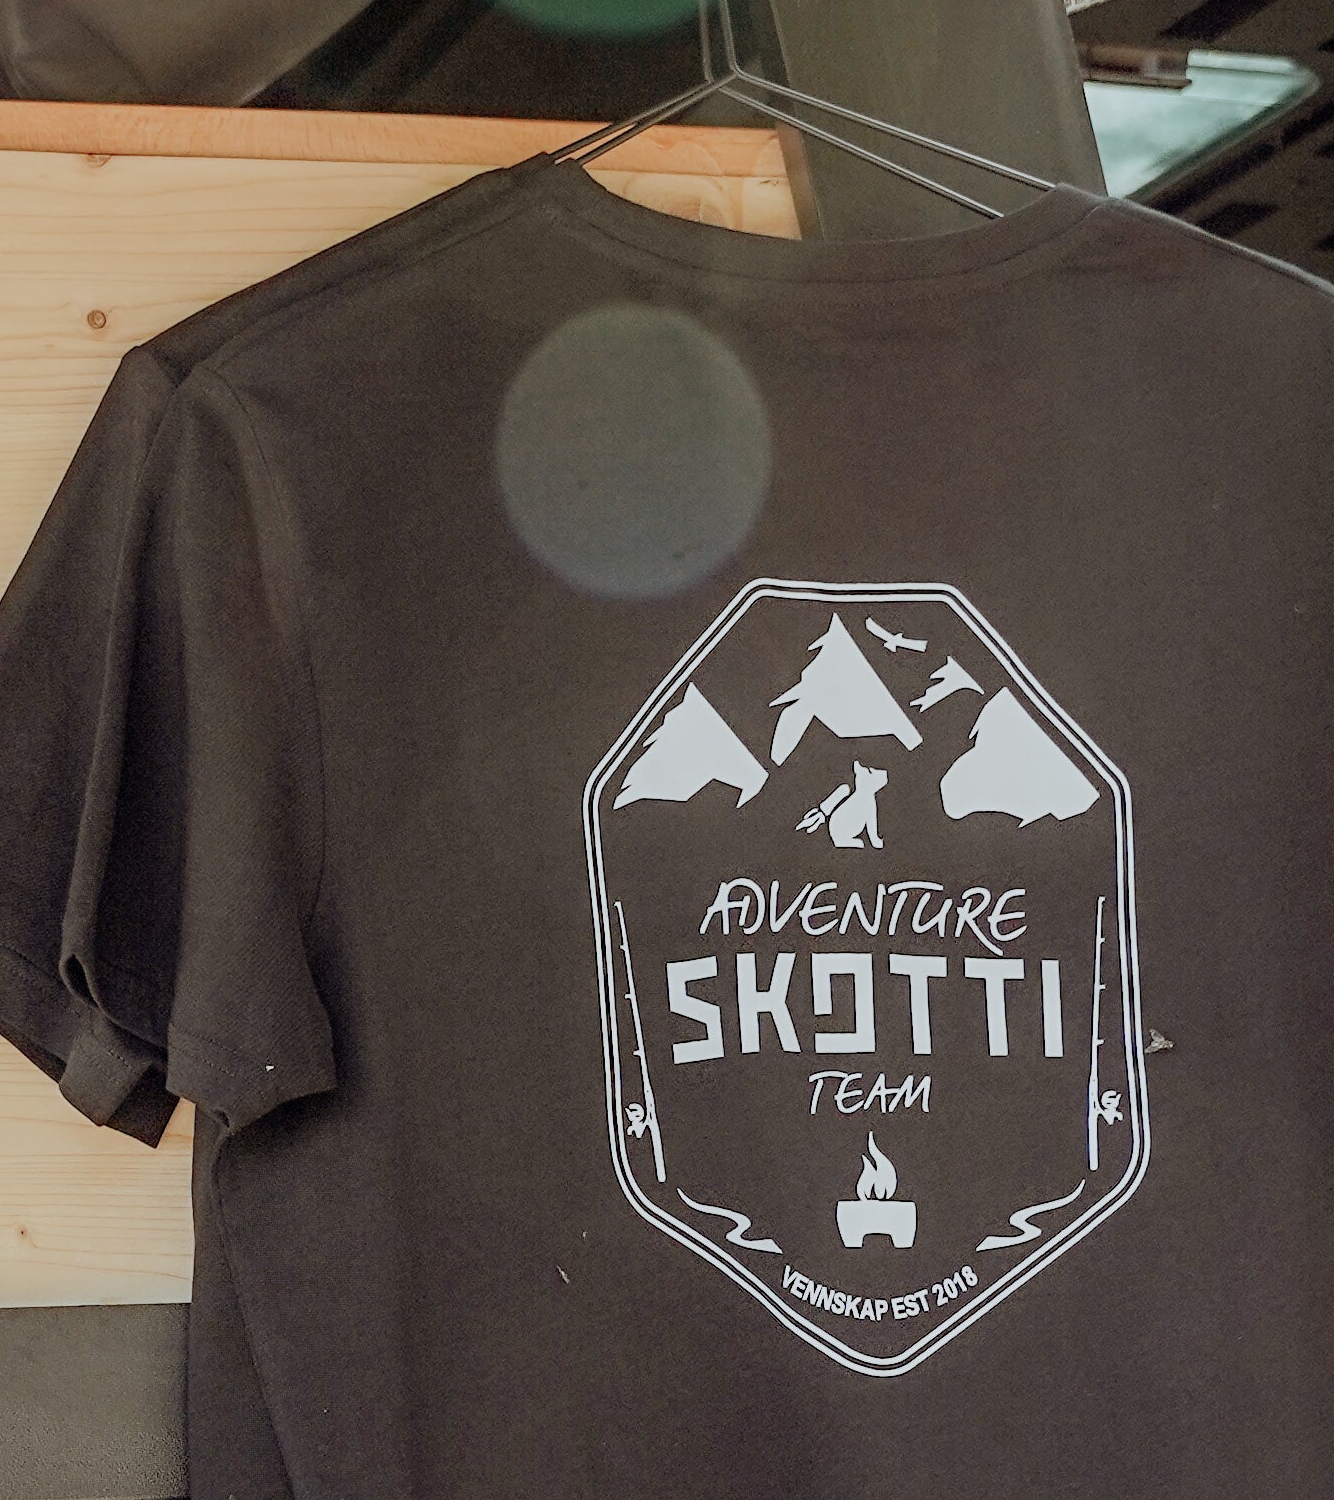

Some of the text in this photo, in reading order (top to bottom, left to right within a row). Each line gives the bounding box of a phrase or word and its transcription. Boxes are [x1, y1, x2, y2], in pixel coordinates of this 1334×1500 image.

[699, 877, 1028, 957] ADVENTURE
[666, 952, 1064, 1065] SKOTTI
[808, 1070, 932, 1115] TEAM
[781, 1263, 979, 1322] VENNSKAP EST 2018
